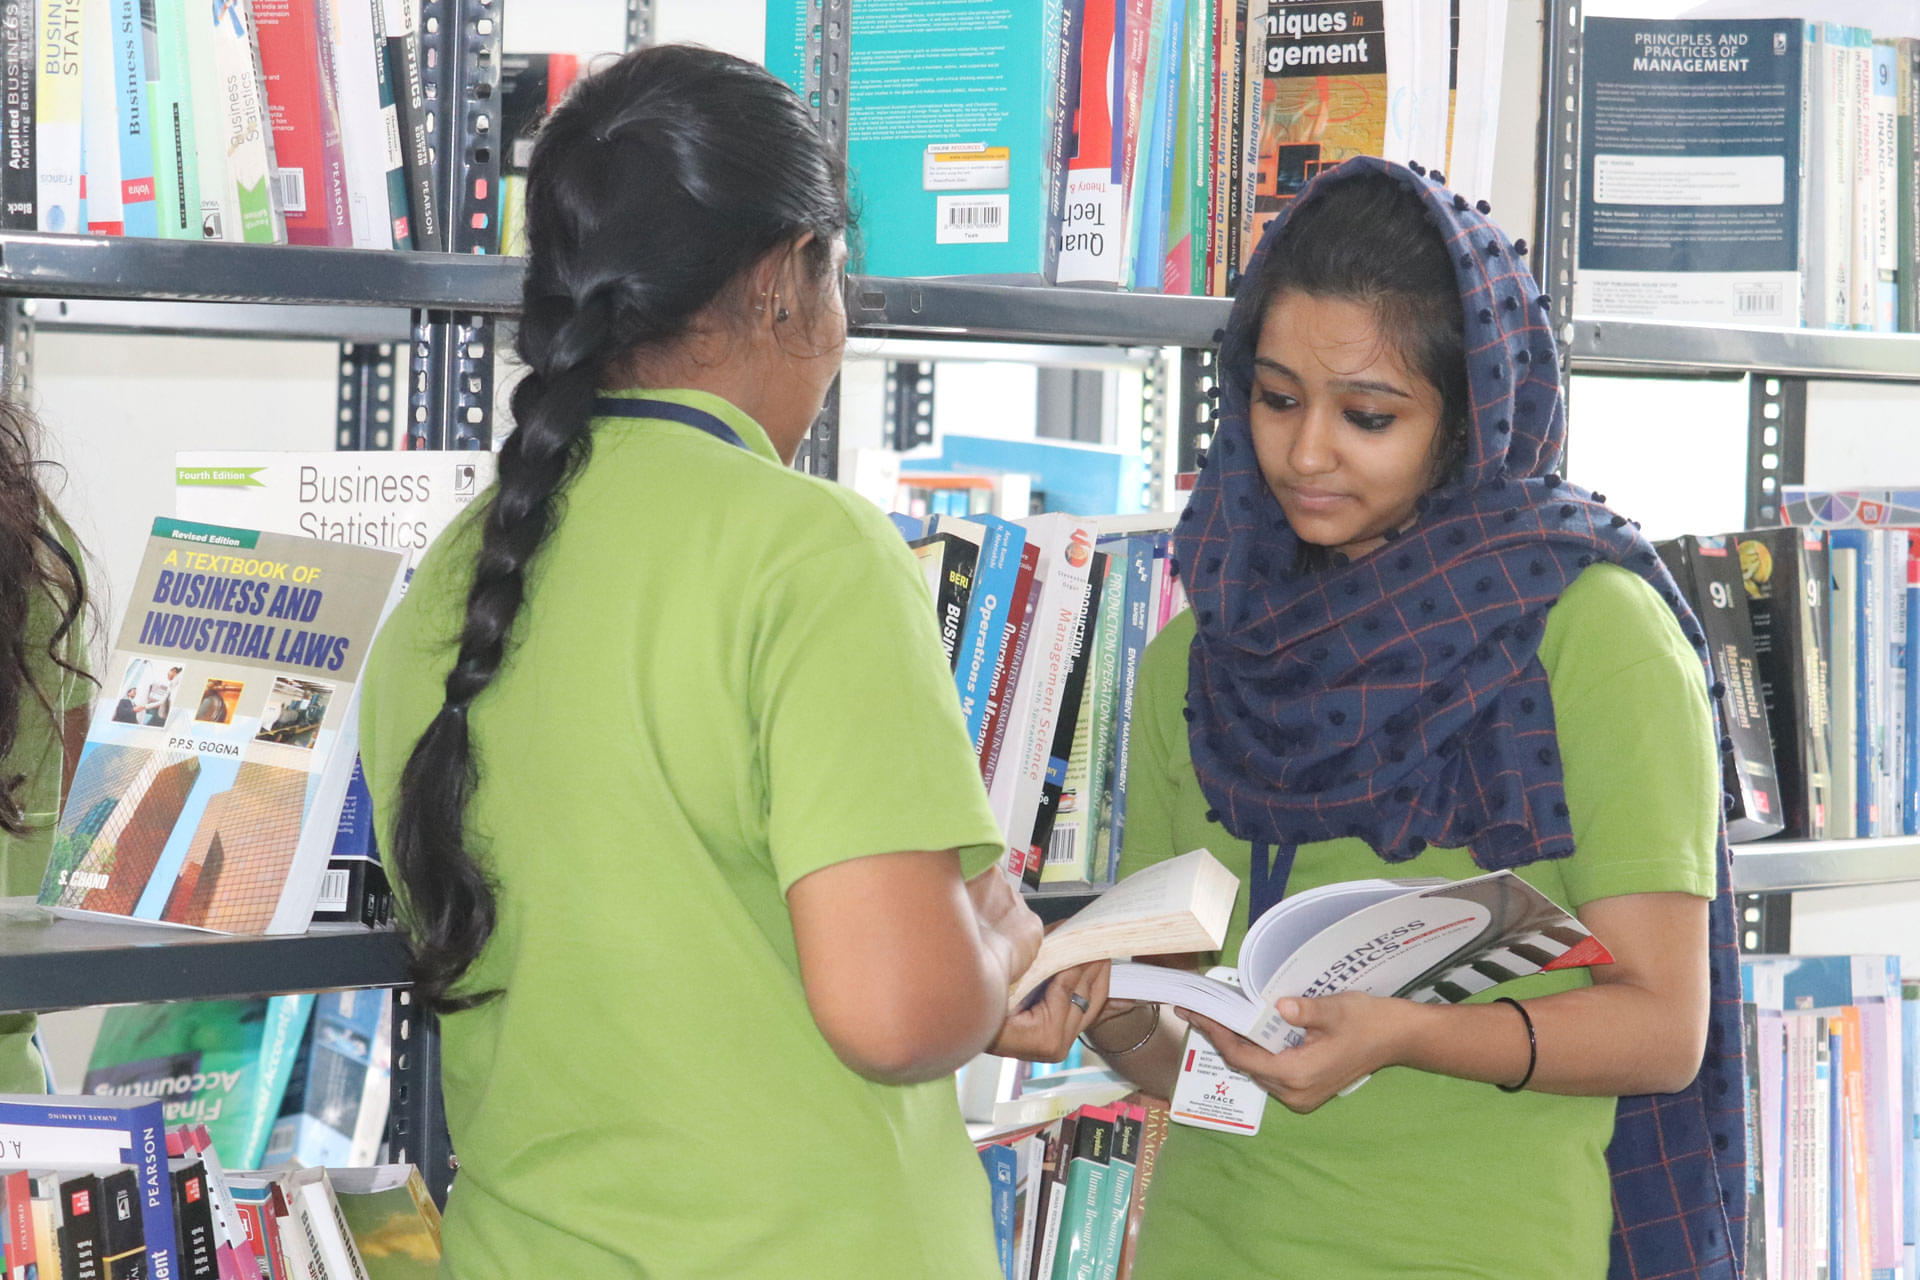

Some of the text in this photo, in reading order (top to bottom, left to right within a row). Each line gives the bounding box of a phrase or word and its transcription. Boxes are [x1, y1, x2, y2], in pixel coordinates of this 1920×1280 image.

[1062, 8, 1072, 36] The
[1351, 11, 1364, 27] in
[1634, 33, 1748, 46] PRINCIPLES AND
[376, 38, 385, 84] Ethics
[406, 37, 421, 110] ETHICS
[1059, 38, 1070, 106] Financial
[1632, 58, 1749, 72] MANAGEMENT
[1644, 45, 1738, 58] PRACTICES OF
[126, 40, 141, 135] Business
[241, 73, 260, 142] Statistics
[1233, 39, 1241, 125] MANAGEMENT
[20, 66, 31, 169] Making Better
[228, 75, 244, 146] Business
[9, 110, 20, 169] Applied
[415, 126, 424, 166] EDITION
[1216, 70, 1228, 264] Total Quality Management
[1231, 127, 1239, 180] QUALITY
[1243, 81, 1261, 234] Materials Management
[1886, 112, 1895, 168] INDIAN
[128, 183, 150, 196] Vohra
[332, 161, 344, 227] PEARSON
[422, 181, 434, 236] PEARSON
[1079, 181, 1106, 193] Theory
[1877, 112, 1887, 256] FINANCIAL SYSTEM
[179, 470, 246, 482] Fourth Edition
[299, 465, 431, 503] Business
[172, 529, 241, 547] Revised Edition
[299, 511, 428, 549] Statistics
[163, 549, 321, 584] A TEXTBOOK OF
[949, 570, 969, 589] BERI
[1807, 579, 1818, 608] 9
[152, 571, 323, 623] BUSINESS AND
[1709, 581, 1727, 609] 9
[139, 612, 349, 673] INDUSTRIAL LAWS
[967, 594, 997, 694] Operations
[1031, 608, 1073, 781] Management Science
[1094, 572, 1123, 810] PRODUCTION OPERATION MANAGEMENT
[1725, 644, 1751, 730] Management
[1739, 658, 1761, 719] Financial
[168, 738, 240, 757] P.P.S. GOGNA
[1119, 648, 1137, 794] ENVIRONMENT MANAGEMENT
[58, 871, 110, 891] S. CHAND
[1302, 919, 1426, 998] BUSINESS
[48, 1112, 88, 1120] LEARNING
[1203, 1093, 1235, 1105] GRACE
[143, 1127, 161, 1208] PEARSON
[1080, 1169, 1103, 1261] Human Resources
[1107, 1167, 1129, 1261] Human Resources
